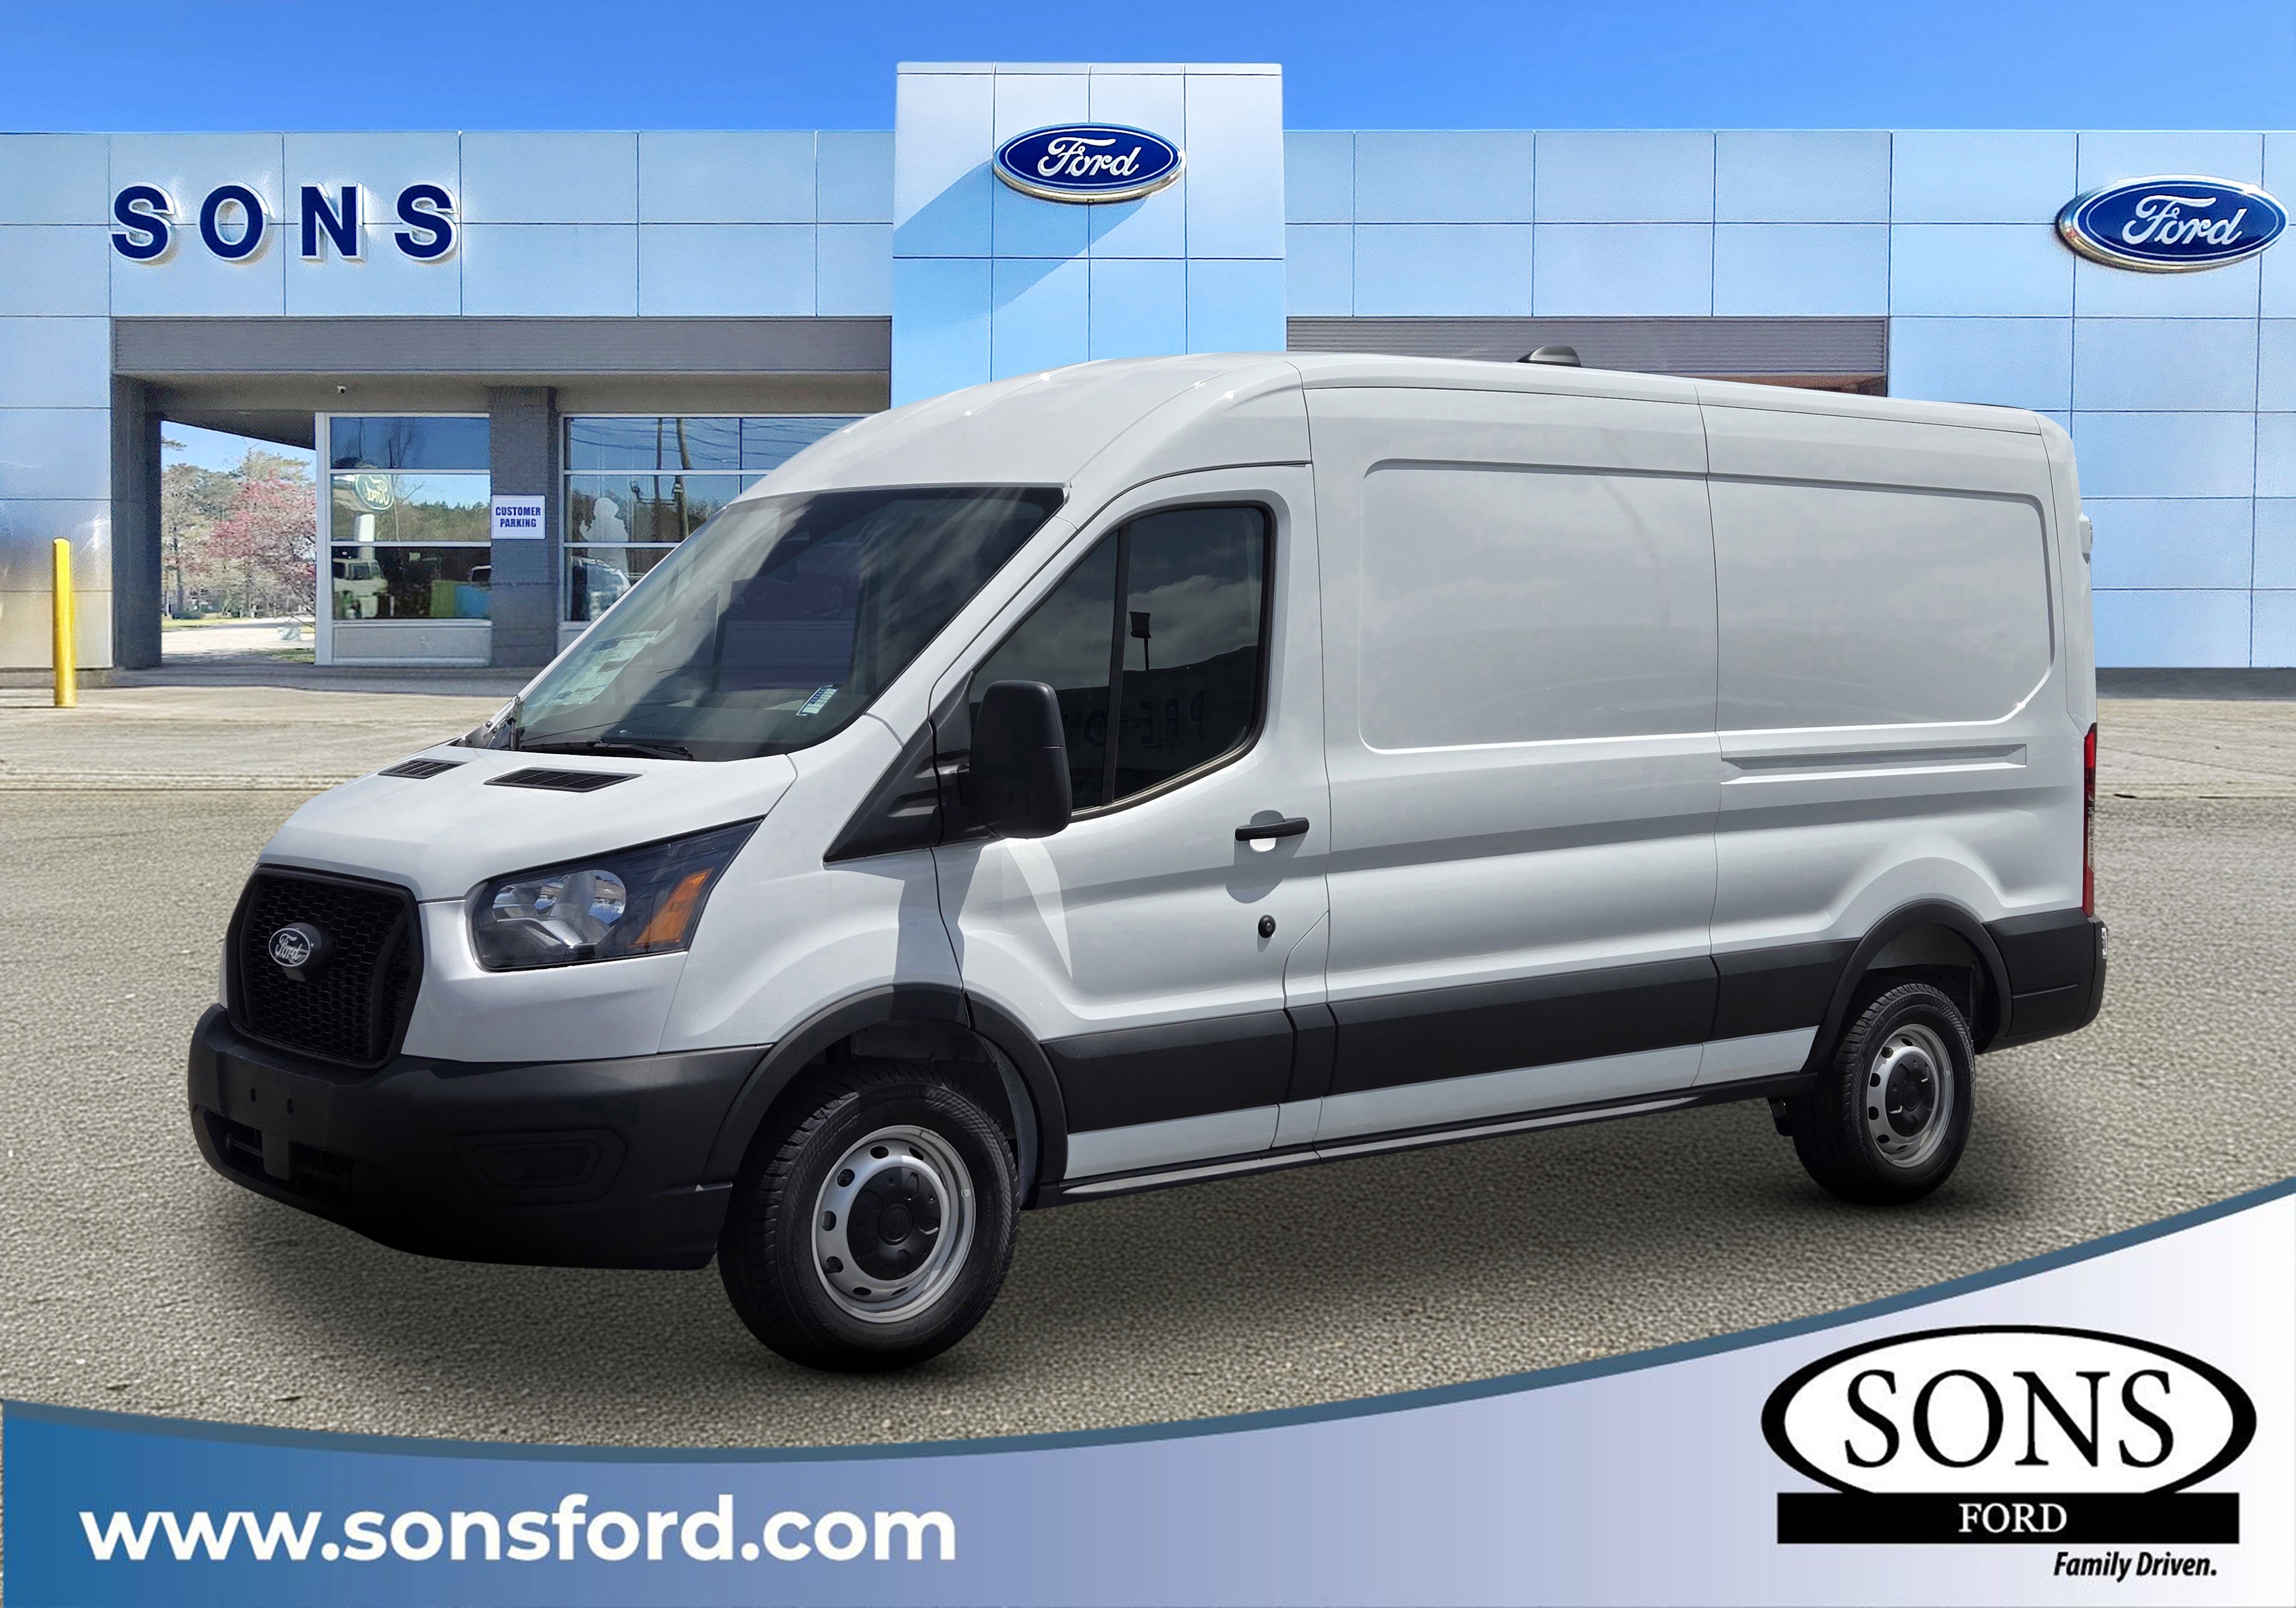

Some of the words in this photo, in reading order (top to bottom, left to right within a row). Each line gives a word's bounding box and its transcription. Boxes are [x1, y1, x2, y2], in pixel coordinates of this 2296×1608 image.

[1037, 137, 1142, 177] Ford
[111, 184, 457, 261] SONS
[2122, 195, 2247, 245] Ford
[495, 507, 541, 516] CUSTOMER
[500, 518, 537, 527] PARKING
[275, 933, 304, 961] Ford
